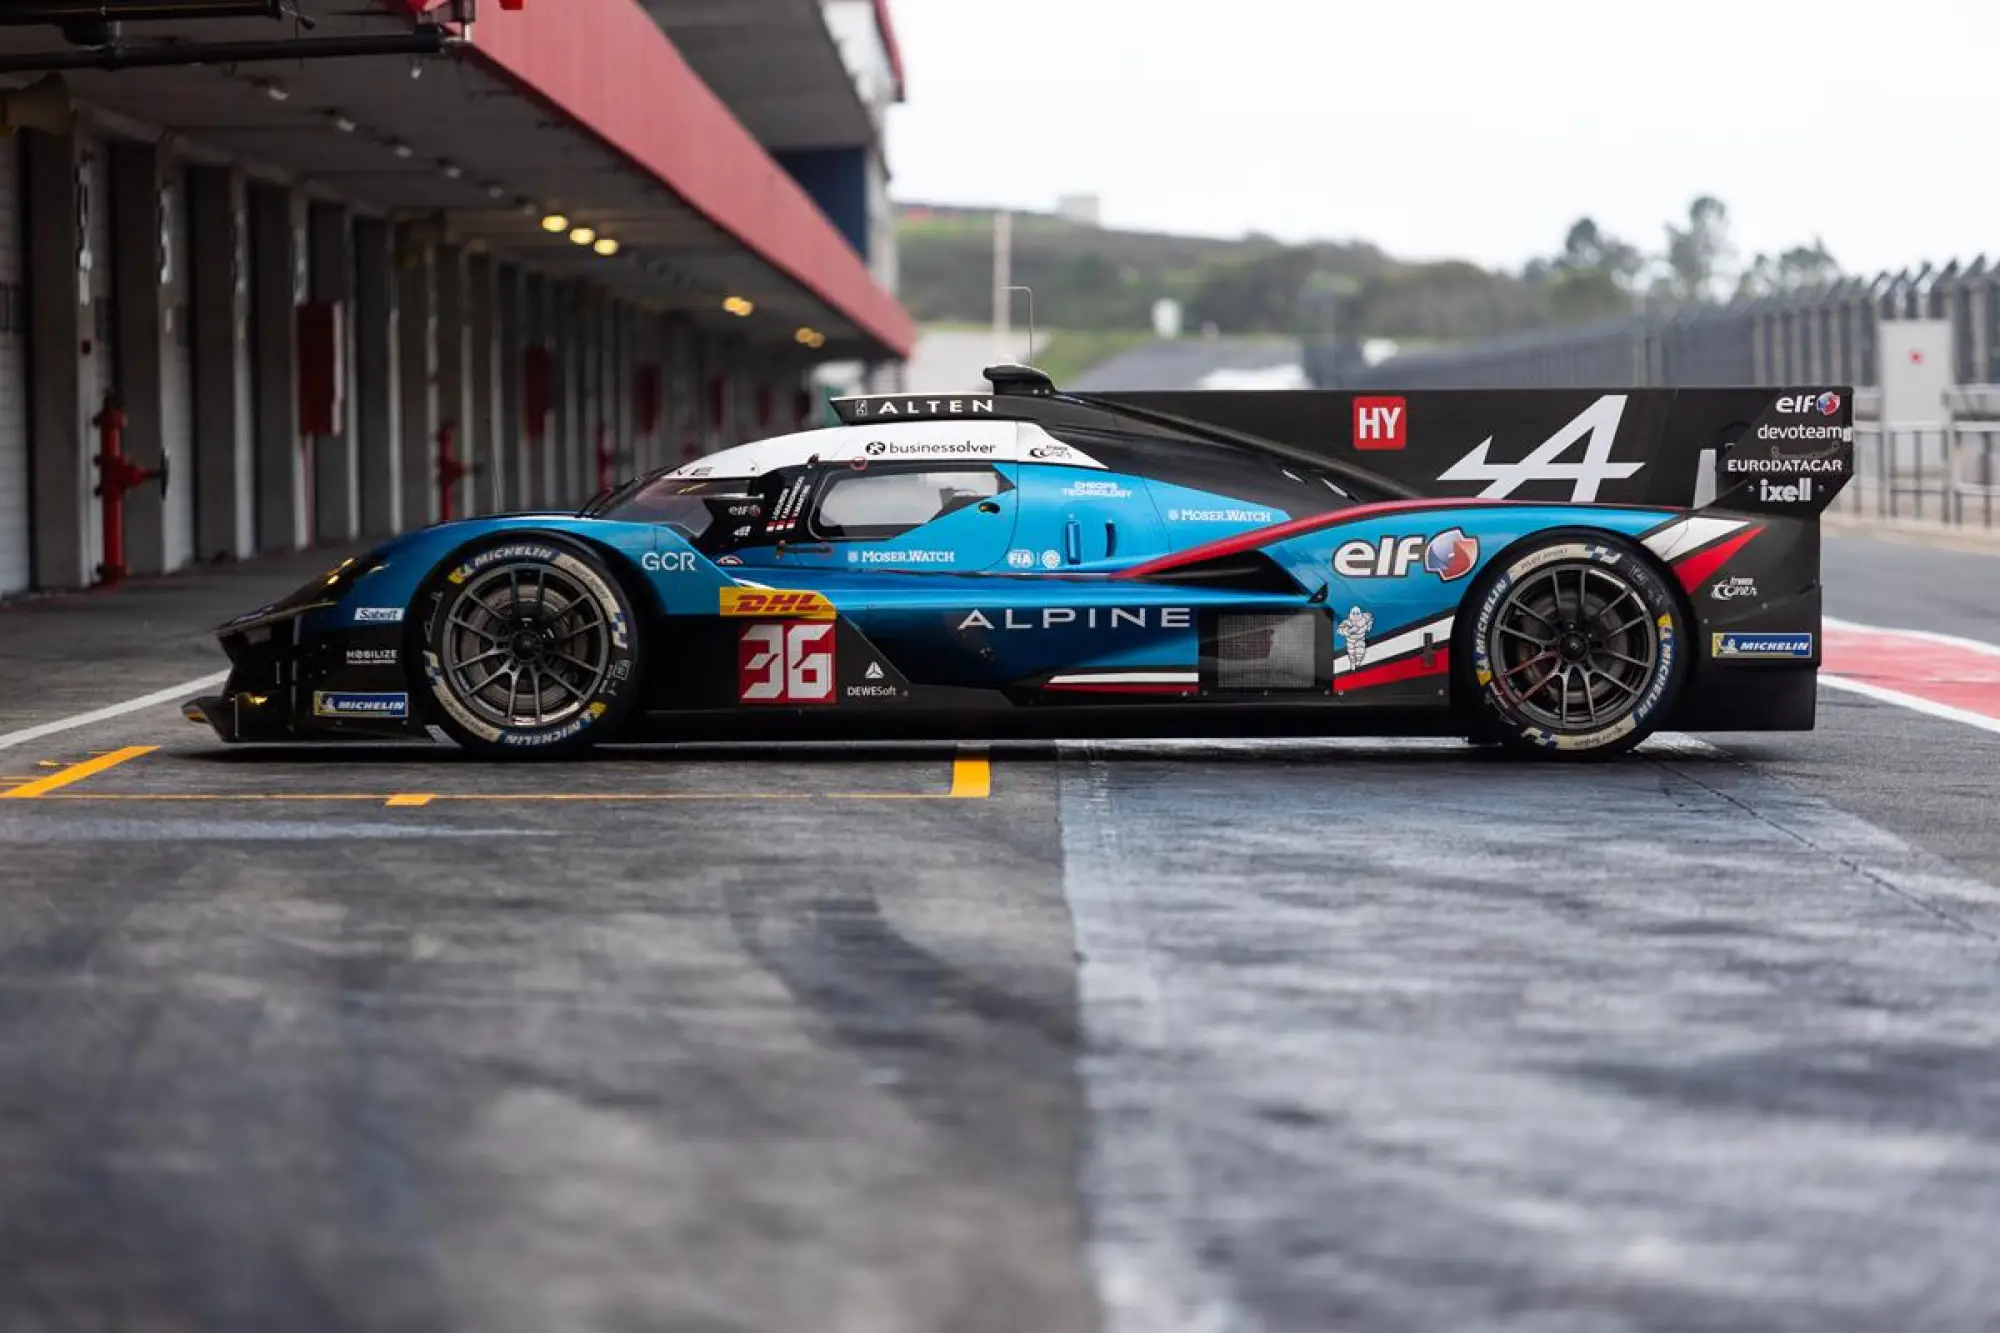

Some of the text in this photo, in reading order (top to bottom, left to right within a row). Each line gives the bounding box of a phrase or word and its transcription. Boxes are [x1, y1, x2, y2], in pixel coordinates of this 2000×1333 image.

[879, 399, 993, 414] ALTEN
[1776, 394, 1816, 413] elf
[1359, 406, 1401, 439] HY
[1757, 423, 1842, 439] devoteam
[889, 440, 996, 455] businessolver
[1727, 460, 1843, 472] EURODATACAR
[1760, 477, 1812, 502] ixell
[474, 544, 552, 567] MICHELIN
[641, 552, 697, 571] GCR
[1332, 535, 1426, 577] elf
[735, 594, 821, 612] DHL
[957, 607, 1191, 630] ALPINE
[1476, 578, 1509, 655] MICHELIN
[1740, 641, 1809, 652] MICHELIN
[740, 624, 834, 699] 36
[1638, 643, 1673, 718] MICHELIN
[847, 686, 897, 697] DEWESoft
[337, 700, 405, 711] MICHELIN
[504, 720, 581, 746] MICHELIN
